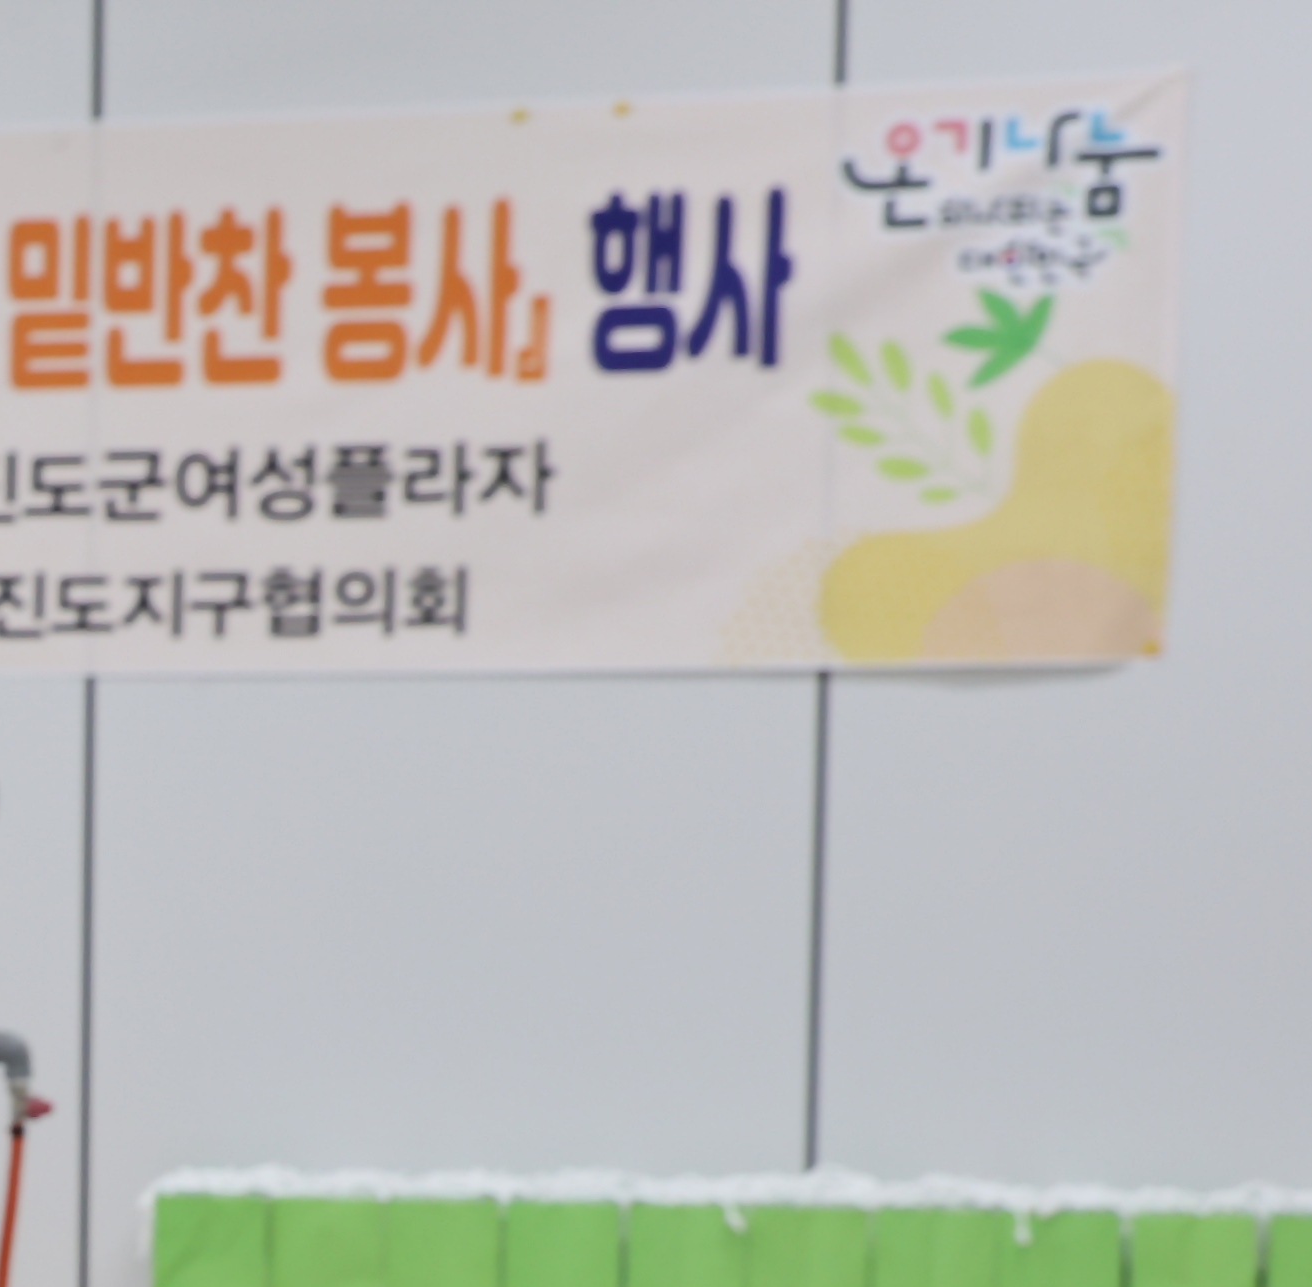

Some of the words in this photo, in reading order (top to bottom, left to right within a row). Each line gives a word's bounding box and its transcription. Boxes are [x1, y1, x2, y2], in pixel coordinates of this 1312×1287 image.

[842, 108, 1161, 228] 온기나눔
[8, 207, 294, 388] 밑반찬
[588, 186, 793, 372] 행사
